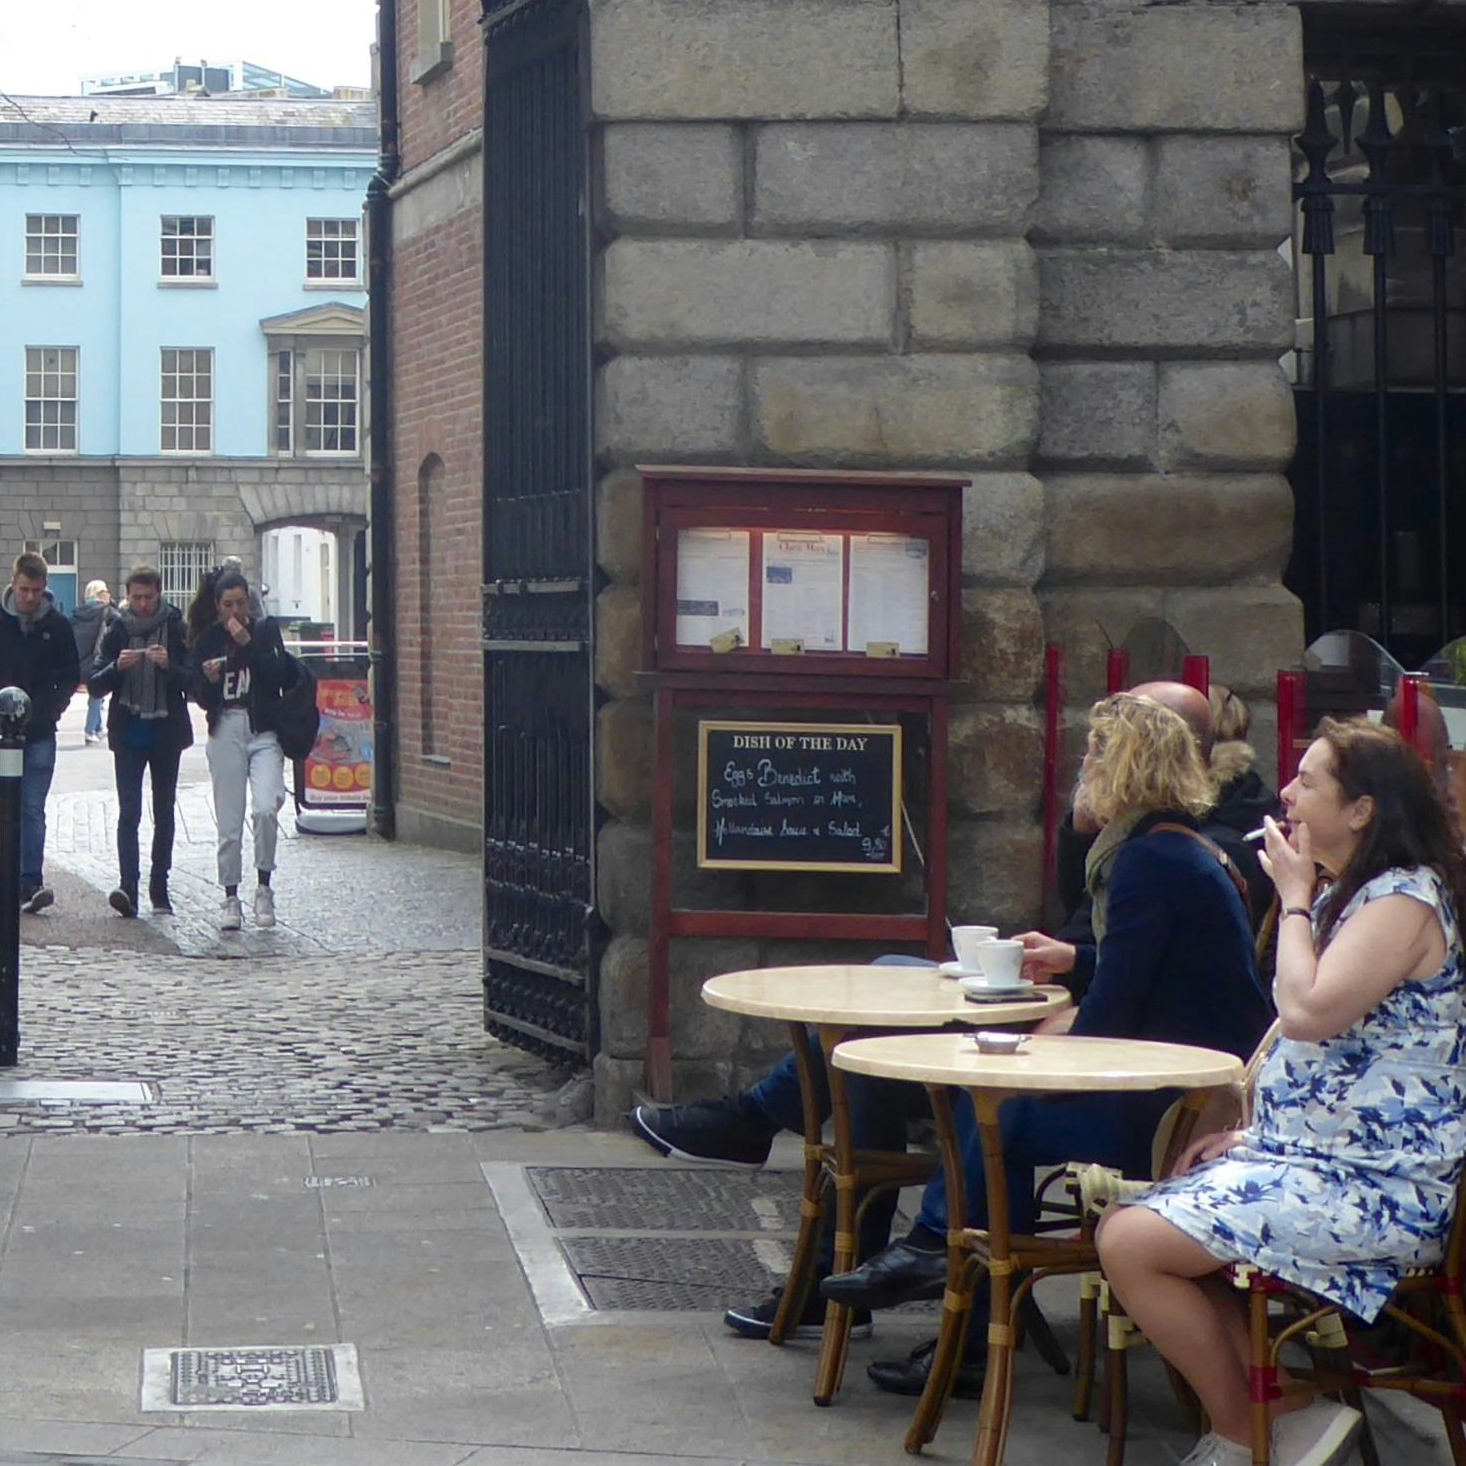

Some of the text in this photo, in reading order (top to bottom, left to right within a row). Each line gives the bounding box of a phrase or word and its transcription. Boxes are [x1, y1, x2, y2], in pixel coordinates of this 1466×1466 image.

[733, 735, 868, 751] DISH OF THE DAY
[724, 758, 857, 788] Eggs Benedict with
[828, 820, 862, 838] Salad
